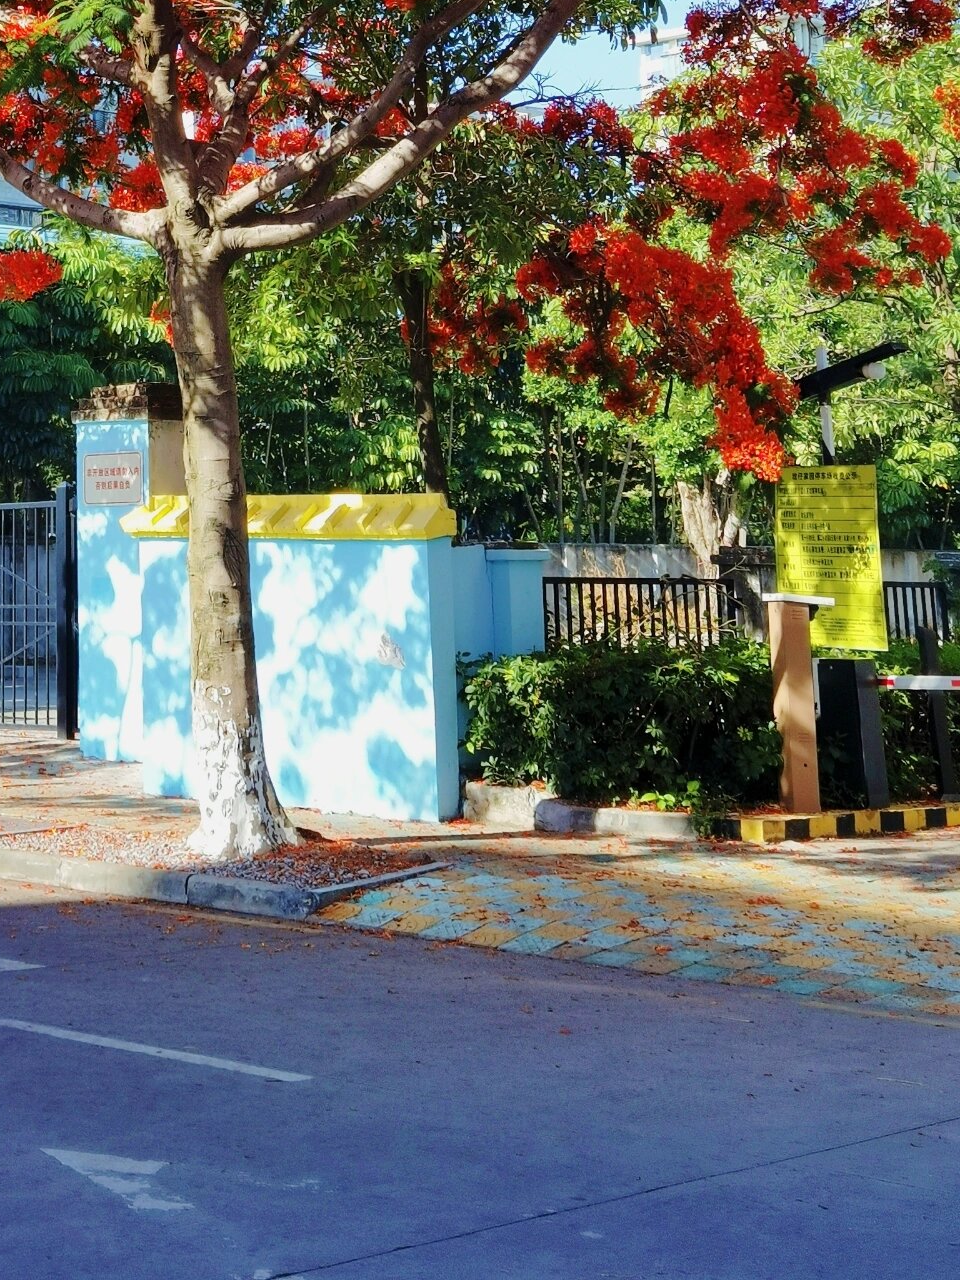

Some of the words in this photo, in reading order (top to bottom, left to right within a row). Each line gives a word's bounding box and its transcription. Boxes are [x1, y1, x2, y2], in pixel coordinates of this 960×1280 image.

[95, 480, 130, 491] 否则后果自负
